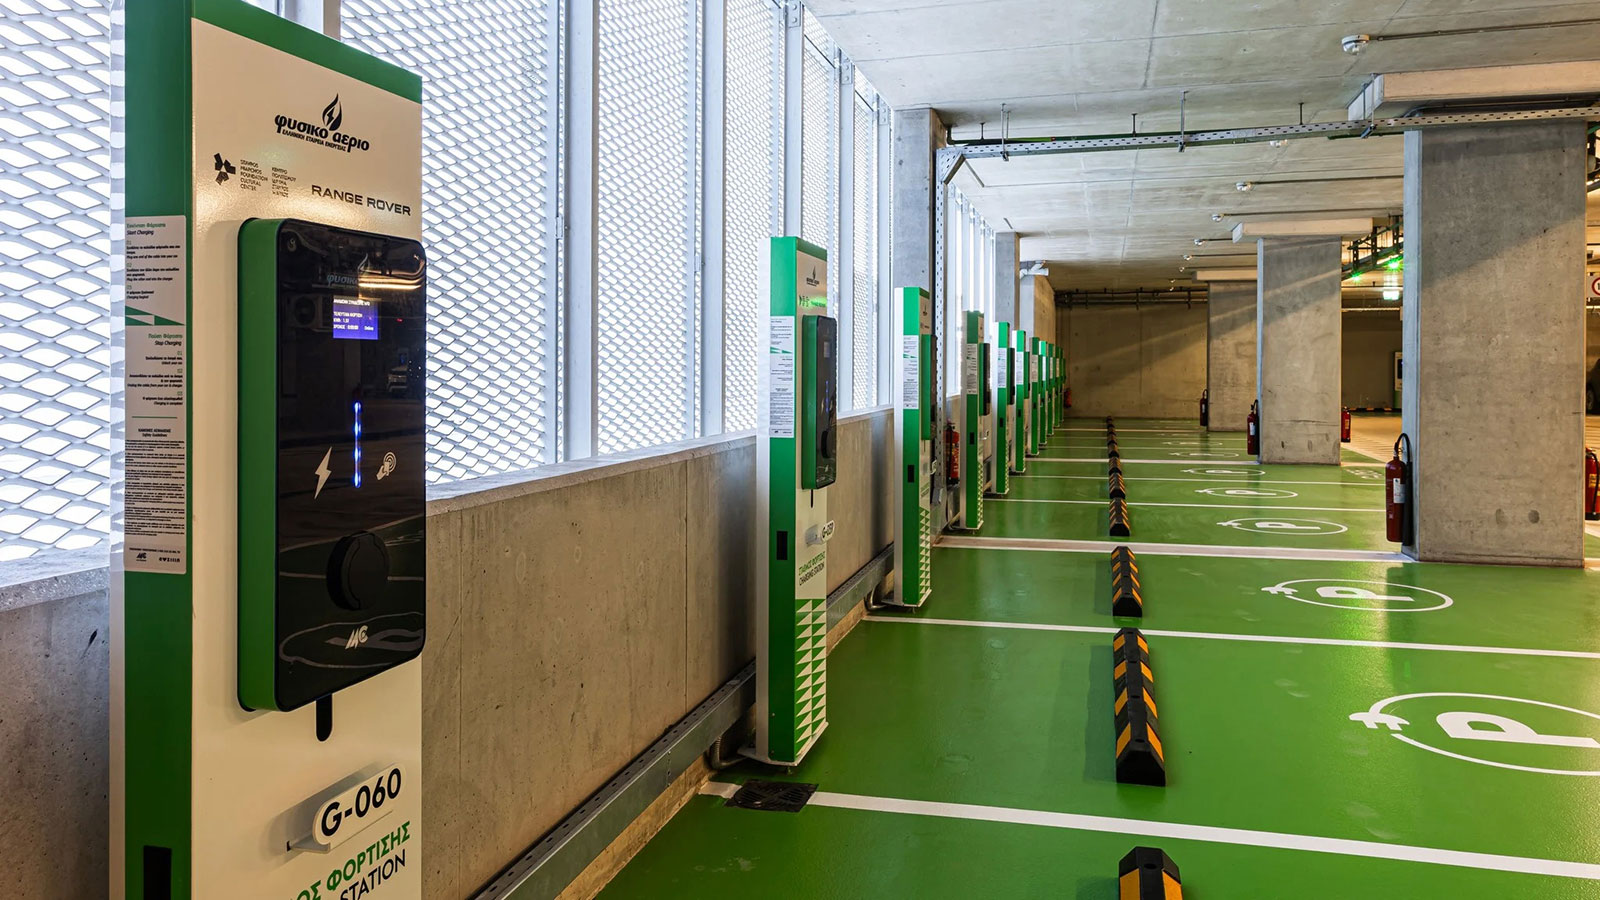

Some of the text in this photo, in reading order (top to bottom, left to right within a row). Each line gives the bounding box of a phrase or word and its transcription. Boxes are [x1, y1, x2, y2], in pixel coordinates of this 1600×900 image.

[274, 114, 370, 153] φυσικο αεριο
[311, 184, 411, 217] RANGE ROVER
[321, 768, 401, 837] G-060
[326, 820, 410, 891] ΦΟΡΤΙΣΗΣ
